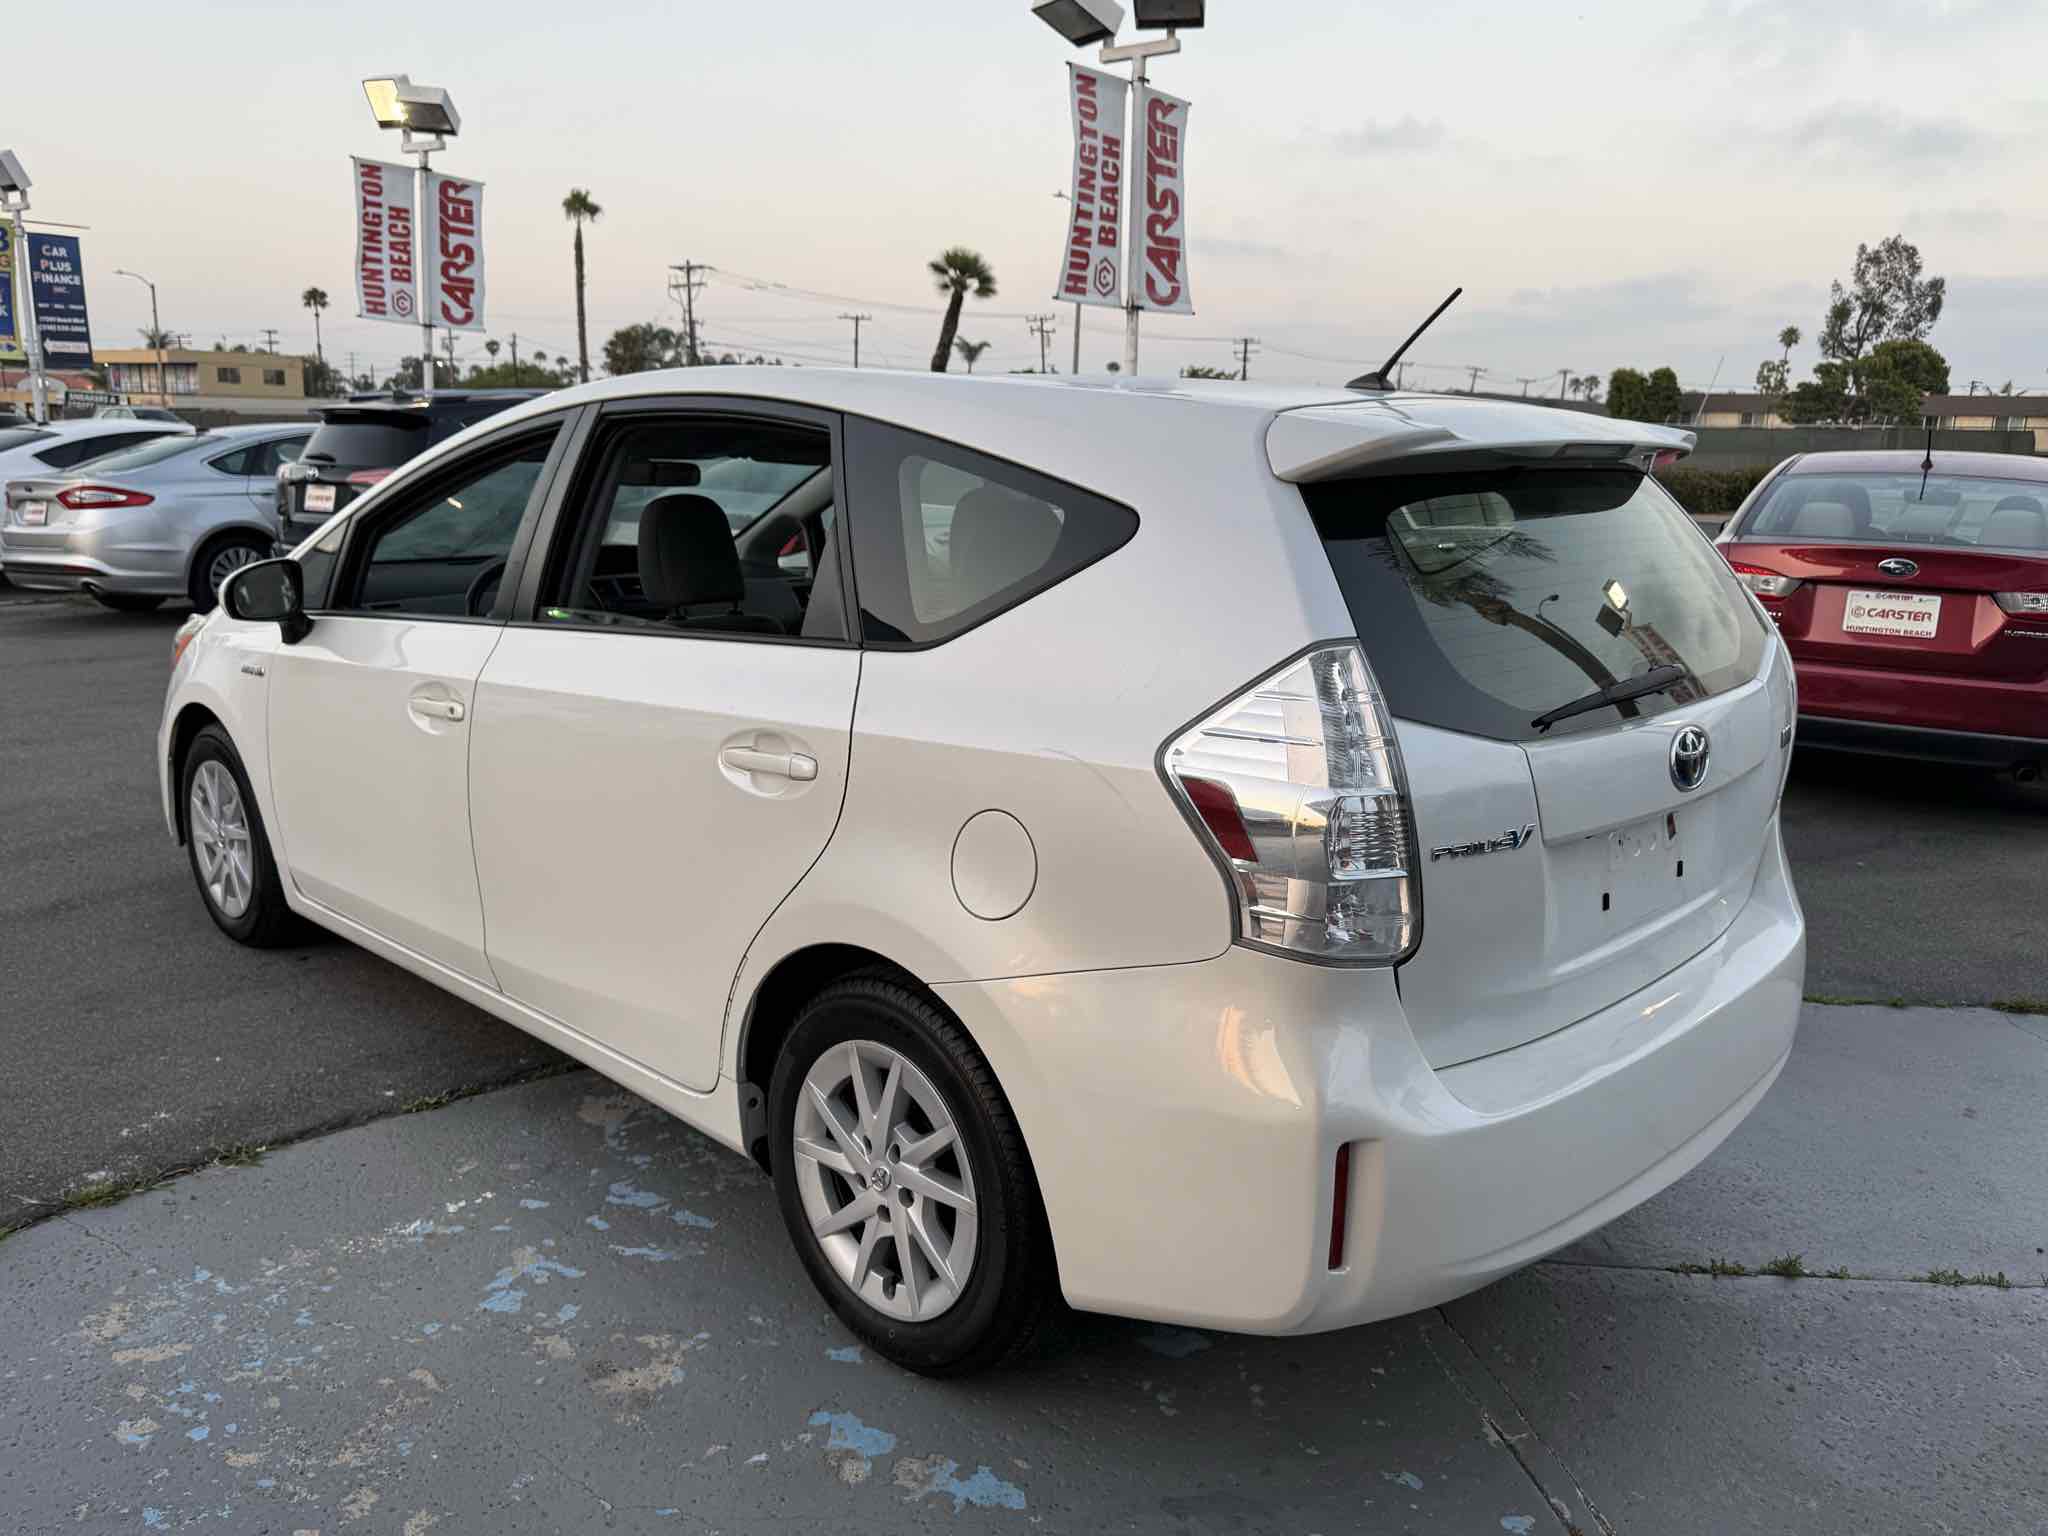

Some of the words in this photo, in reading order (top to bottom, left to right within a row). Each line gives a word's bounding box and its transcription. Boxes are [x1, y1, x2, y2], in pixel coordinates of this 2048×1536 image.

[1064, 73, 1099, 296] HUNTINGTON
[1097, 133, 1121, 248] BEACH
[1145, 97, 1181, 306] CARSTER
[40, 258, 72, 272] PLUS
[41, 244, 68, 257] CAR
[360, 163, 387, 316] HUNTINGTON
[388, 206, 412, 283] BEACH
[439, 180, 475, 326] CARSTER
[33, 271, 81, 286] FINANCE
[1845, 624, 1901, 635] HUNTINGTON
[1903, 629, 1933, 637] BEACH
[1867, 607, 1932, 622] CARSTER
